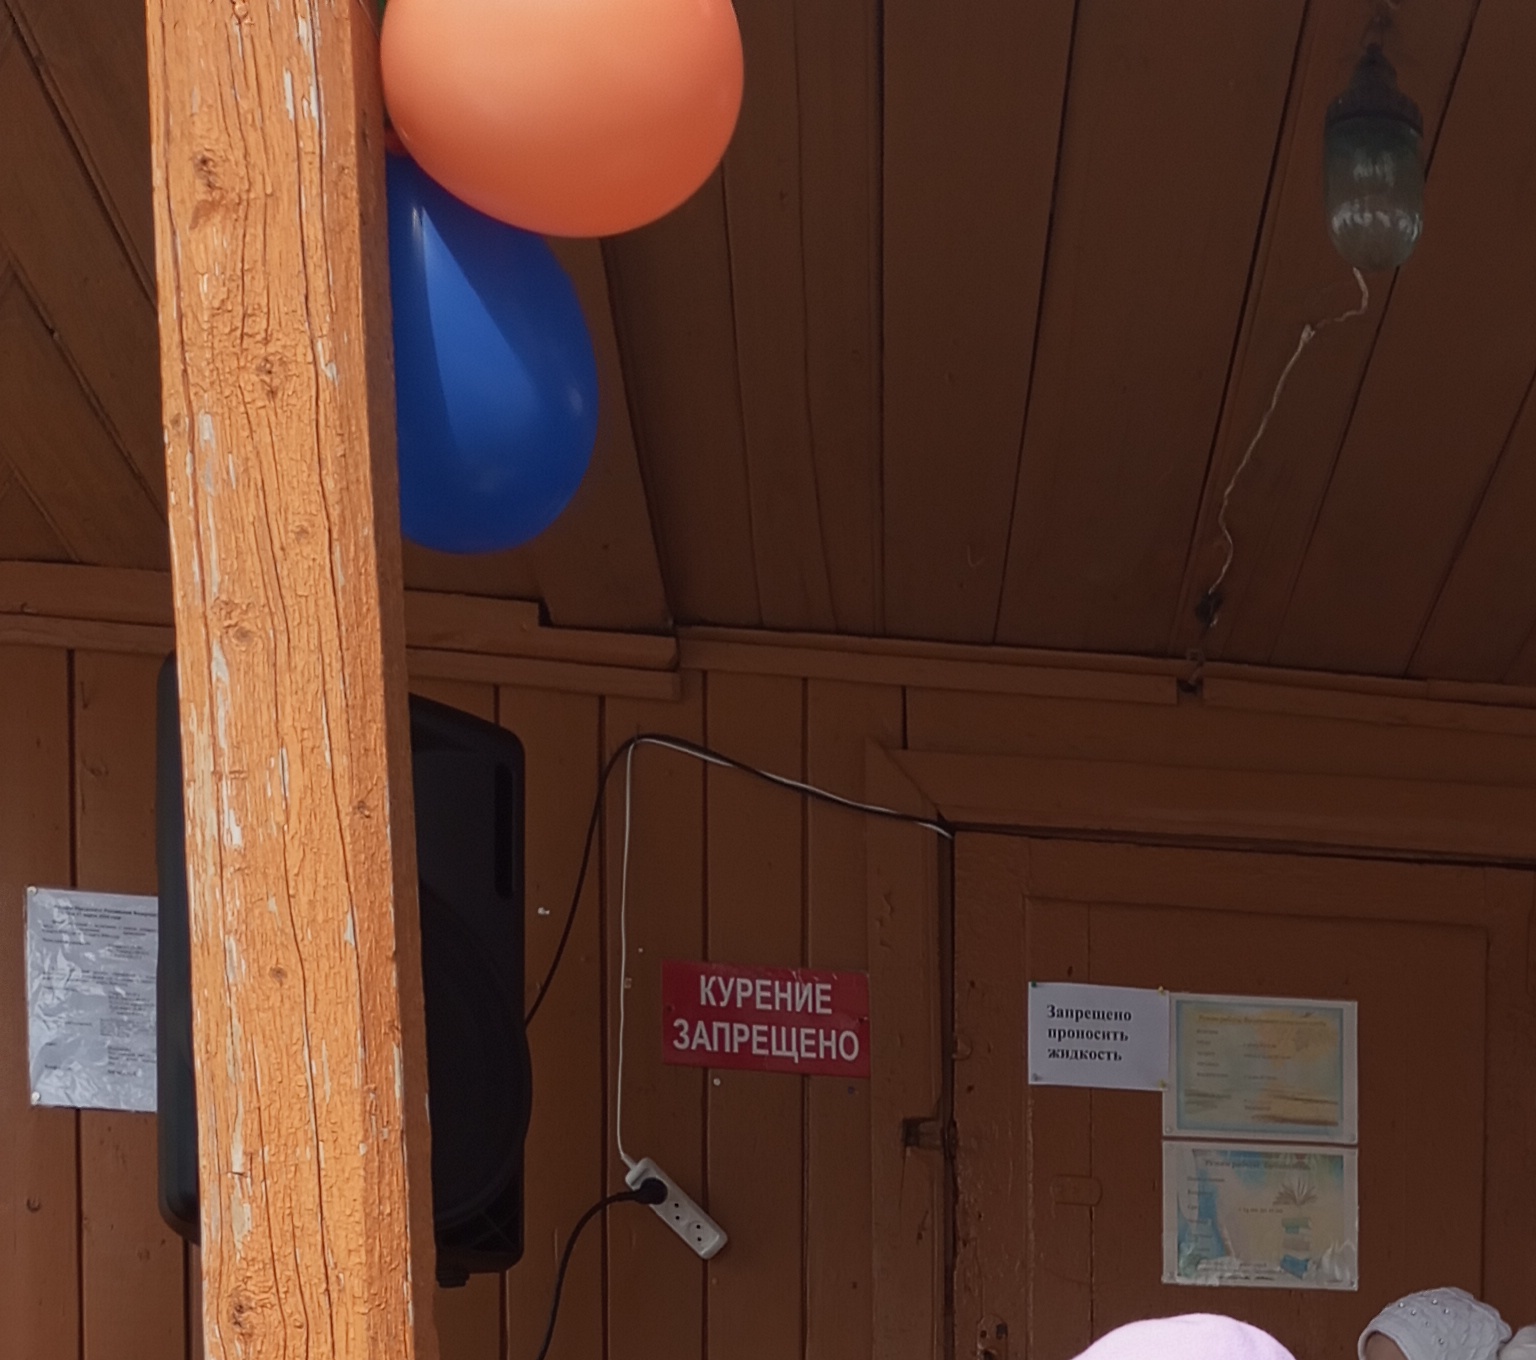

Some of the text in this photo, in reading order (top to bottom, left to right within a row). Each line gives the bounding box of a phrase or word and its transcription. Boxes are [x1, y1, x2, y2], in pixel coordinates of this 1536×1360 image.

[699, 973, 833, 1015] КУРЕНИЕ
[1046, 1003, 1133, 1023] Запрещено
[672, 1017, 860, 1064] ЗАПРЕЩЕНО
[1047, 1027, 1129, 1043] проносить
[1046, 1047, 1123, 1062] жидкость
